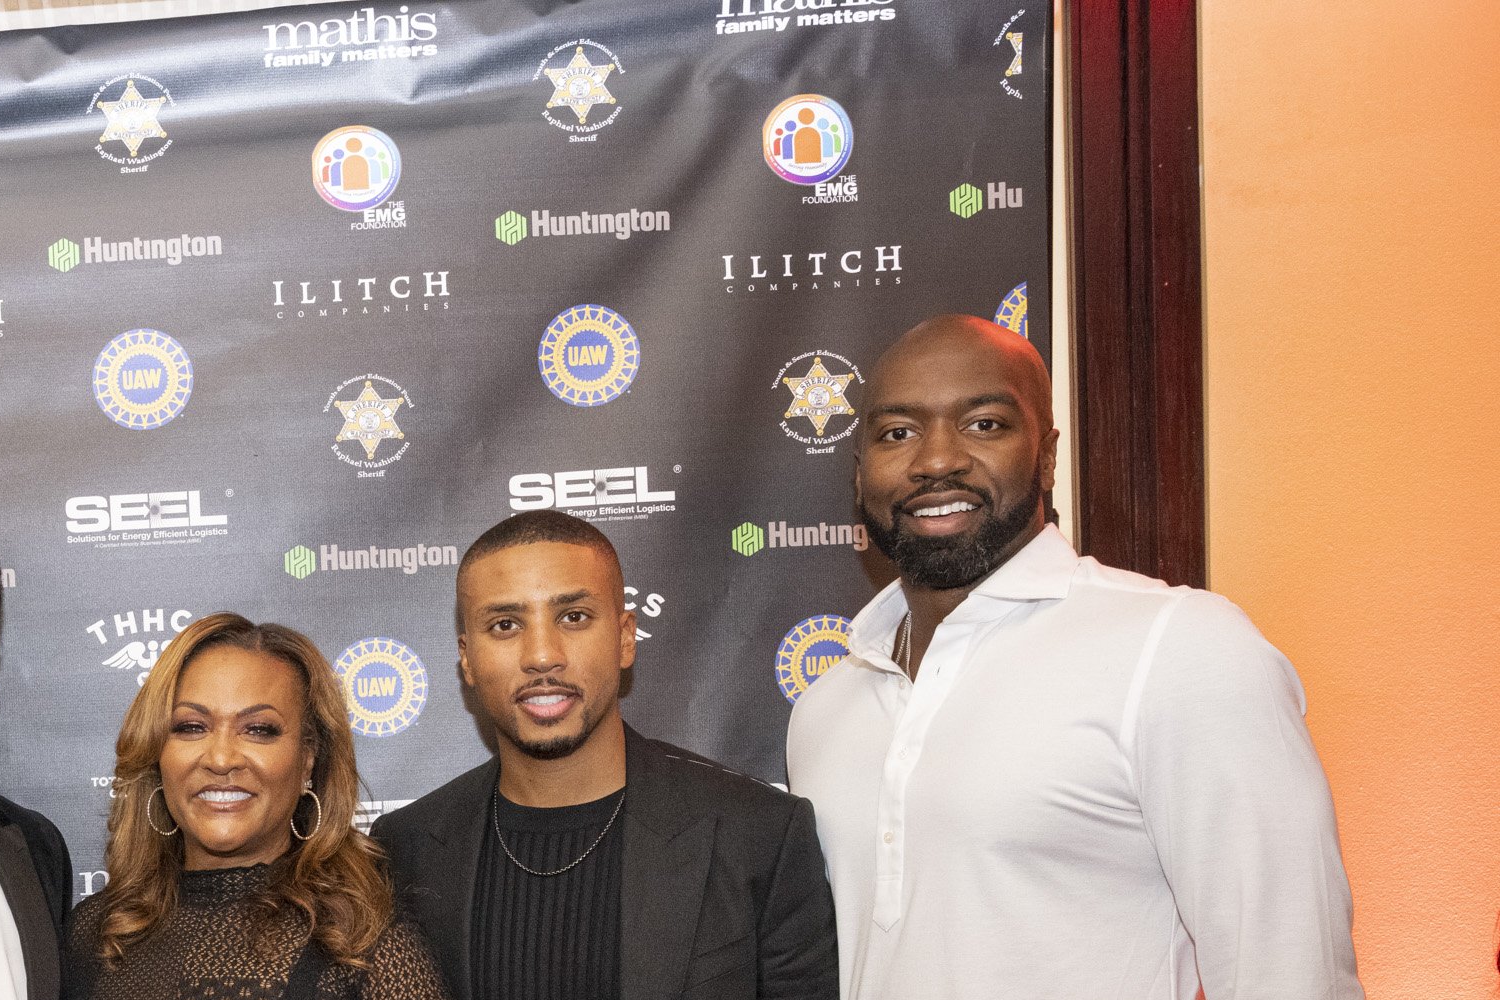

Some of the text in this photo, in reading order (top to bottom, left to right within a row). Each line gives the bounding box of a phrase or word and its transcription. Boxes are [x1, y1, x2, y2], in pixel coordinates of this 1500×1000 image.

[262, 5, 437, 51] mathis
[715, 17, 790, 34] family
[797, 8, 896, 27] matters
[264, 43, 438, 68] family matters
[532, 39, 626, 81] Youth Senior Education Fund
[542, 106, 622, 132] Raphael Washington
[569, 134, 598, 142] Sheriff
[814, 182, 858, 197] EMG
[839, 175, 856, 183] THE
[387, 201, 404, 209] THE
[802, 194, 858, 204] FOUNDATION
[350, 219, 406, 230] FOUNDATION
[363, 208, 406, 223] EMG
[531, 208, 670, 240] Huntington
[84, 234, 222, 265] Huntington
[722, 245, 902, 280] ILITCH
[273, 271, 449, 306] ILITCH
[726, 277, 901, 293] COMPANIES
[276, 301, 449, 319] COMPANIES
[568, 345, 608, 366] UAW
[122, 368, 162, 391] UAW
[771, 368, 786, 390] Youth
[792, 351, 815, 363] Senior
[816, 350, 852, 367] Education
[851, 365, 865, 384] Fund
[323, 374, 415, 413] Youth Senior Education Fund
[779, 417, 860, 444] Raphael Washington
[331, 442, 410, 468] Raphael Washington
[806, 446, 835, 454] Sheriff
[358, 470, 386, 478] Sheriff
[508, 466, 676, 511] SEEL
[65, 490, 228, 533] SEEL
[567, 504, 676, 518] Energy Efficient Logistics
[67, 527, 228, 544] Solutions for Energy Efficient Logistics
[768, 521, 868, 552] Hunting
[320, 544, 458, 574] Huntington
[86, 609, 193, 645] THHC
[357, 676, 396, 698] UAW
